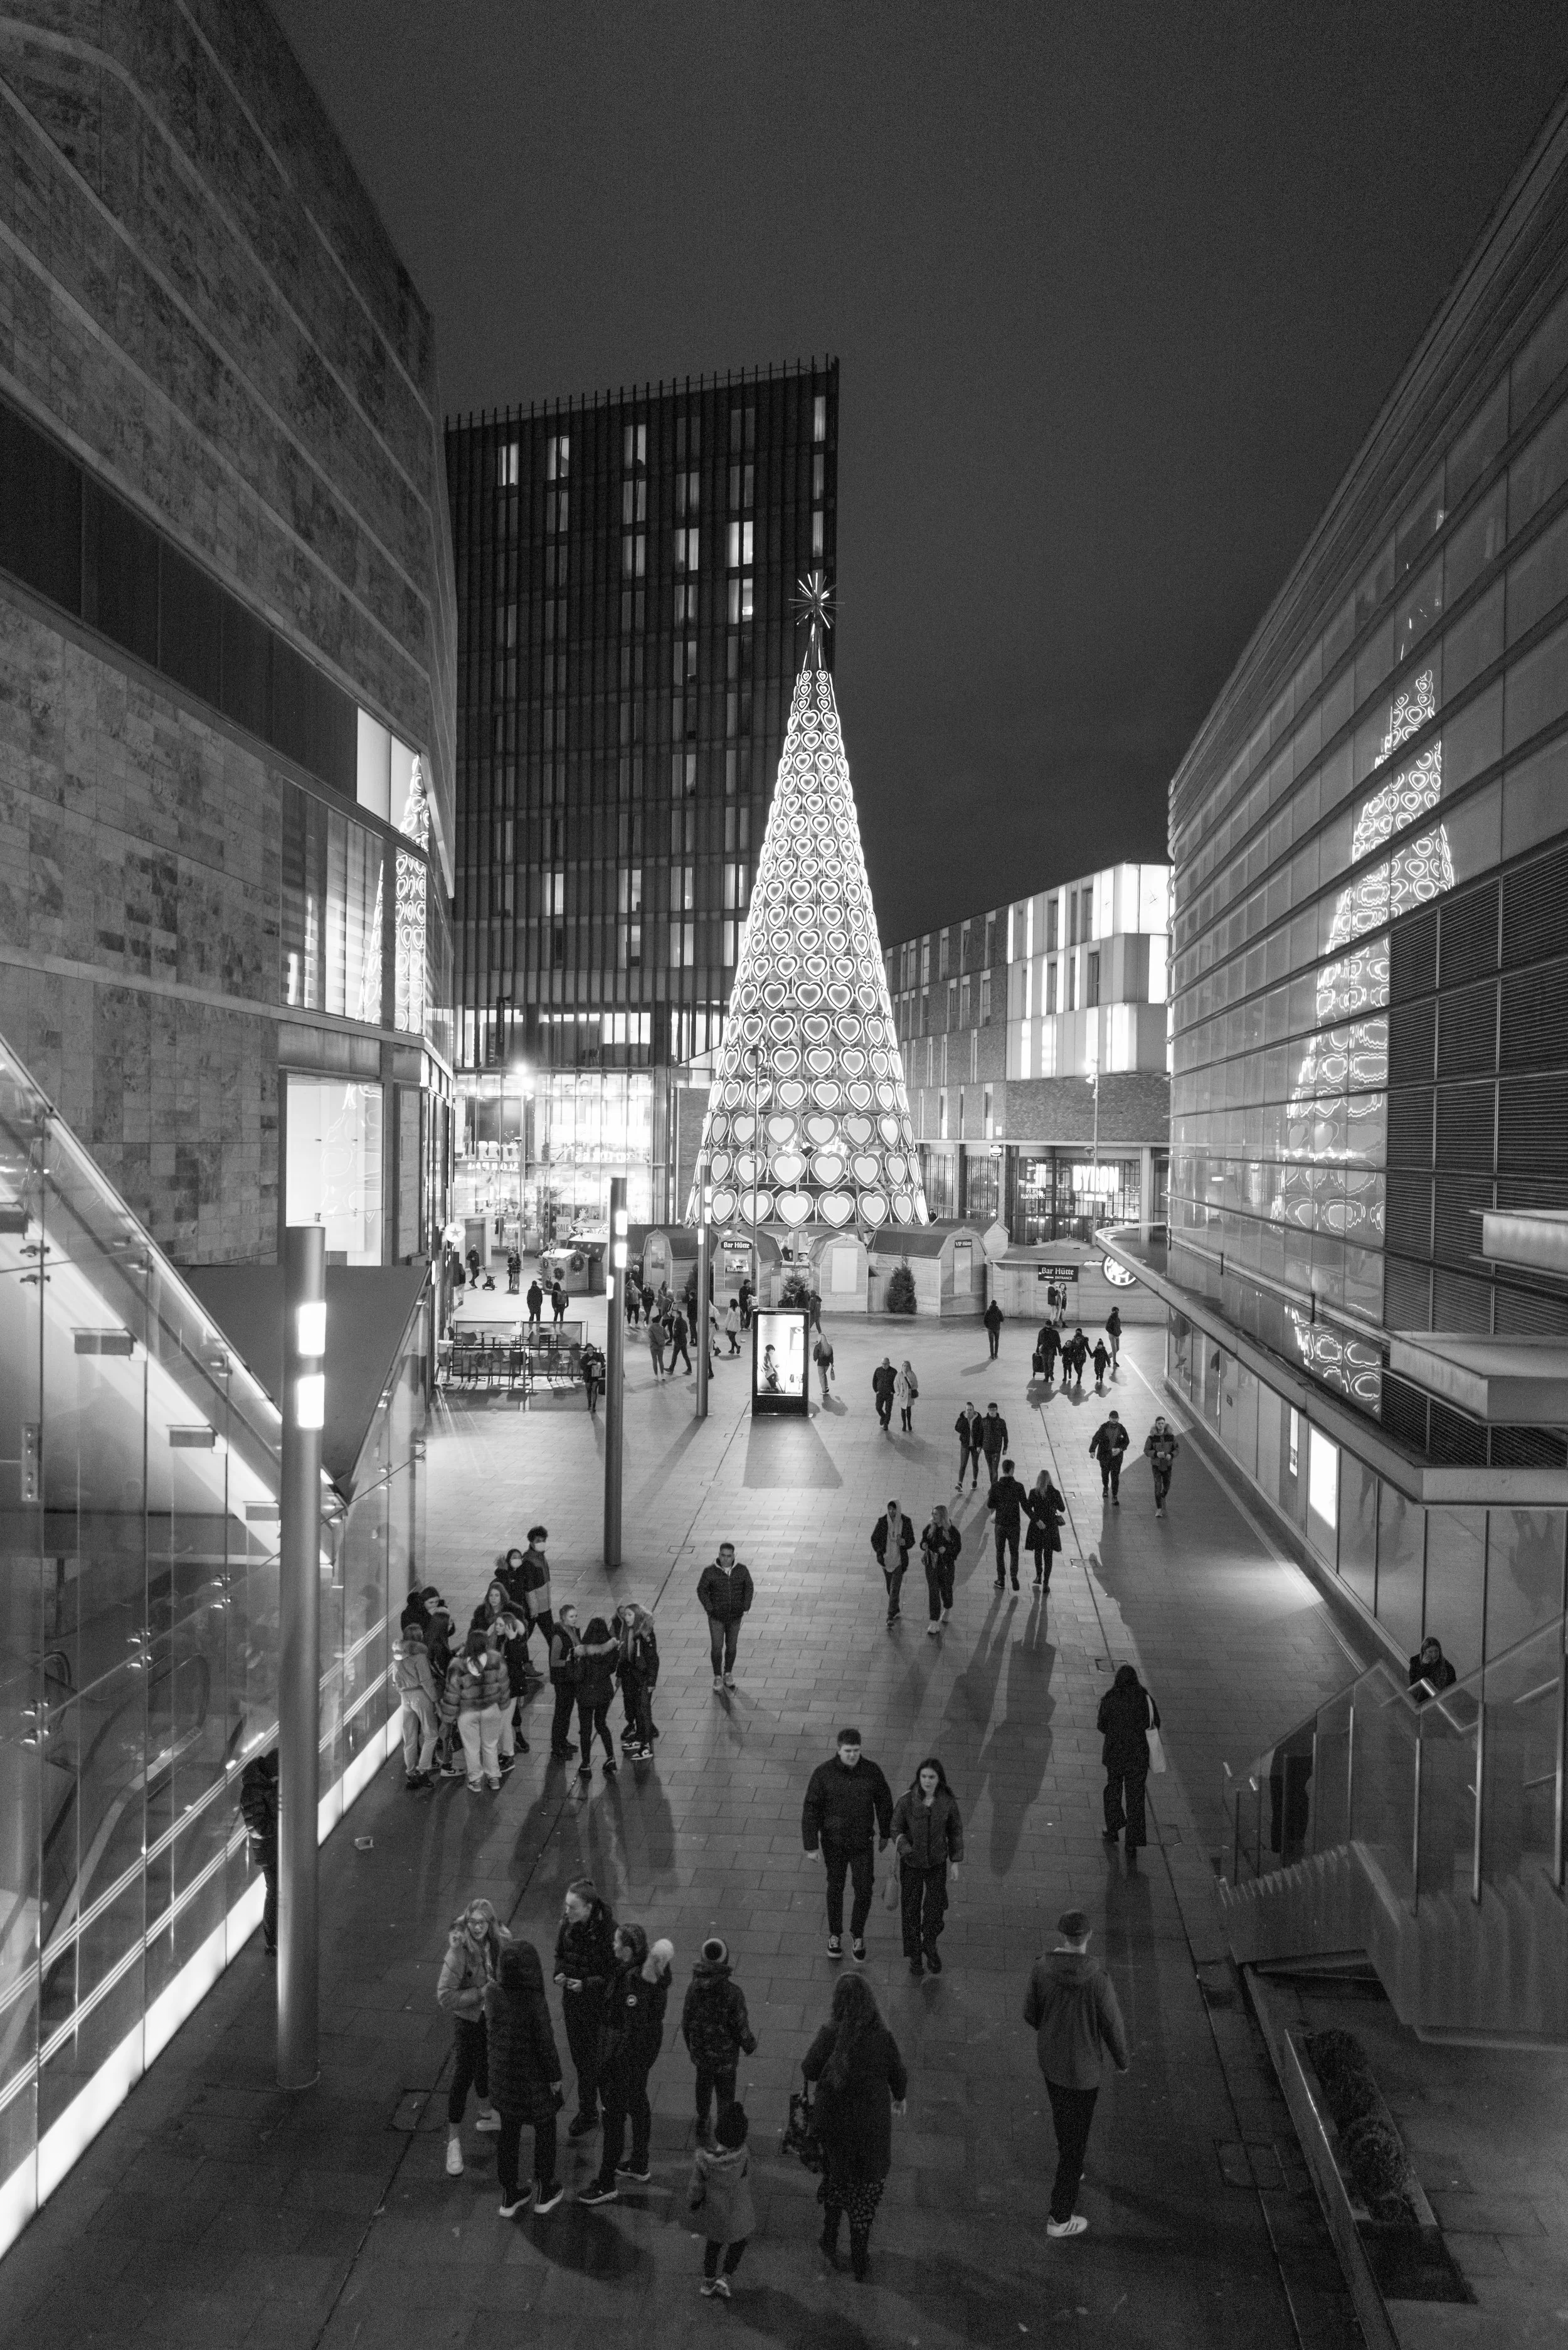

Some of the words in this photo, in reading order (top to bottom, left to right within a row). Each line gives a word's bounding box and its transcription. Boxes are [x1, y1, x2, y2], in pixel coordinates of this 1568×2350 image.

[1073, 1166, 1119, 1193] BYRON
[557, 1224, 569, 1232] SALE
[1055, 1267, 1074, 1275] Hütte
